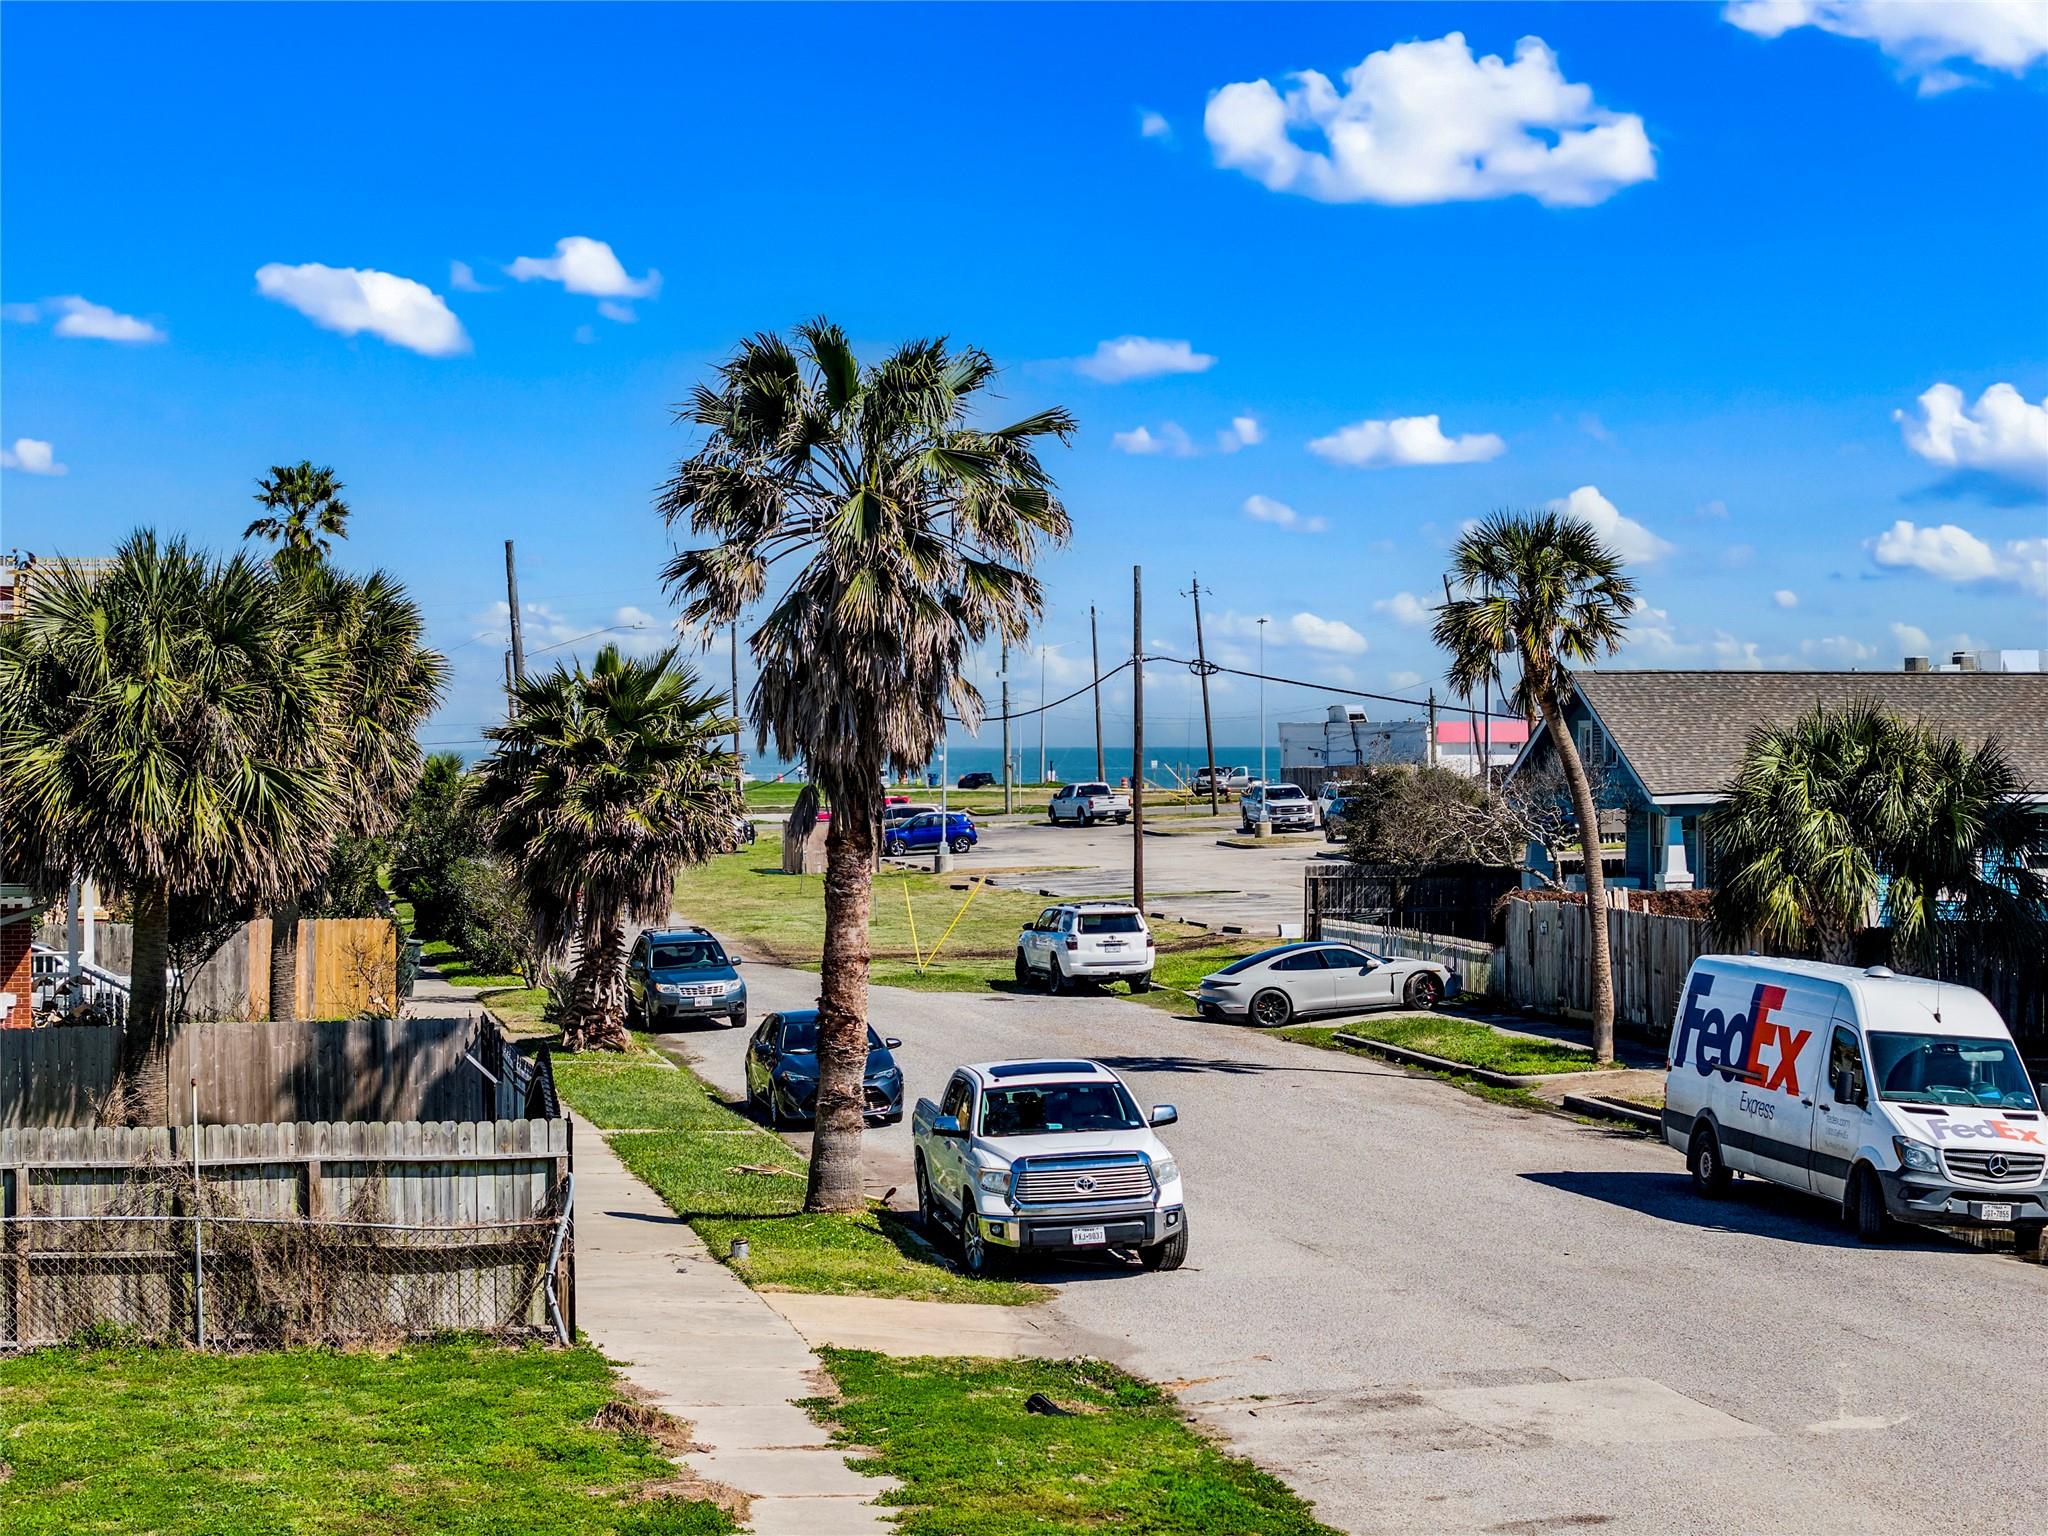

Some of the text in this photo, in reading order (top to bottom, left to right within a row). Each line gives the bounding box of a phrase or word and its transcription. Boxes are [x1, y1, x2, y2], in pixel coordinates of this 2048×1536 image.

[1674, 972, 1812, 1096] FedEx
[1740, 1090, 1775, 1120] Express
[1926, 1119, 2046, 1146] FedEx
